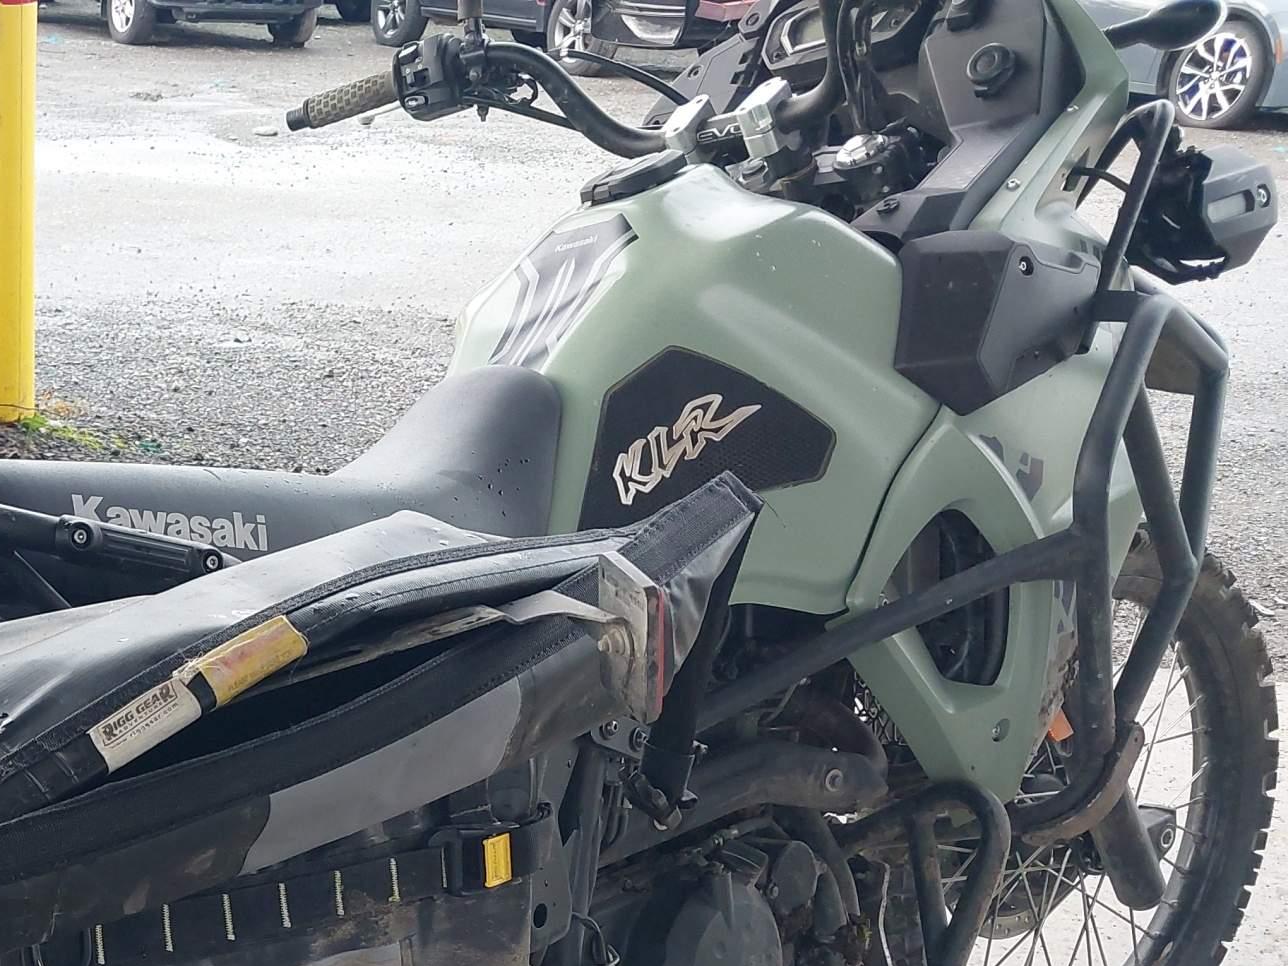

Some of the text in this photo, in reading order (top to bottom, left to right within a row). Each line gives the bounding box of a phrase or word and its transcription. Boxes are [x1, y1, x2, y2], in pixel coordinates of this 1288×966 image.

[613, 393, 762, 505] KLR
[71, 493, 268, 551] Kawasaki
[101, 711, 134, 741] RIGG
[135, 684, 175, 714] GEAR
